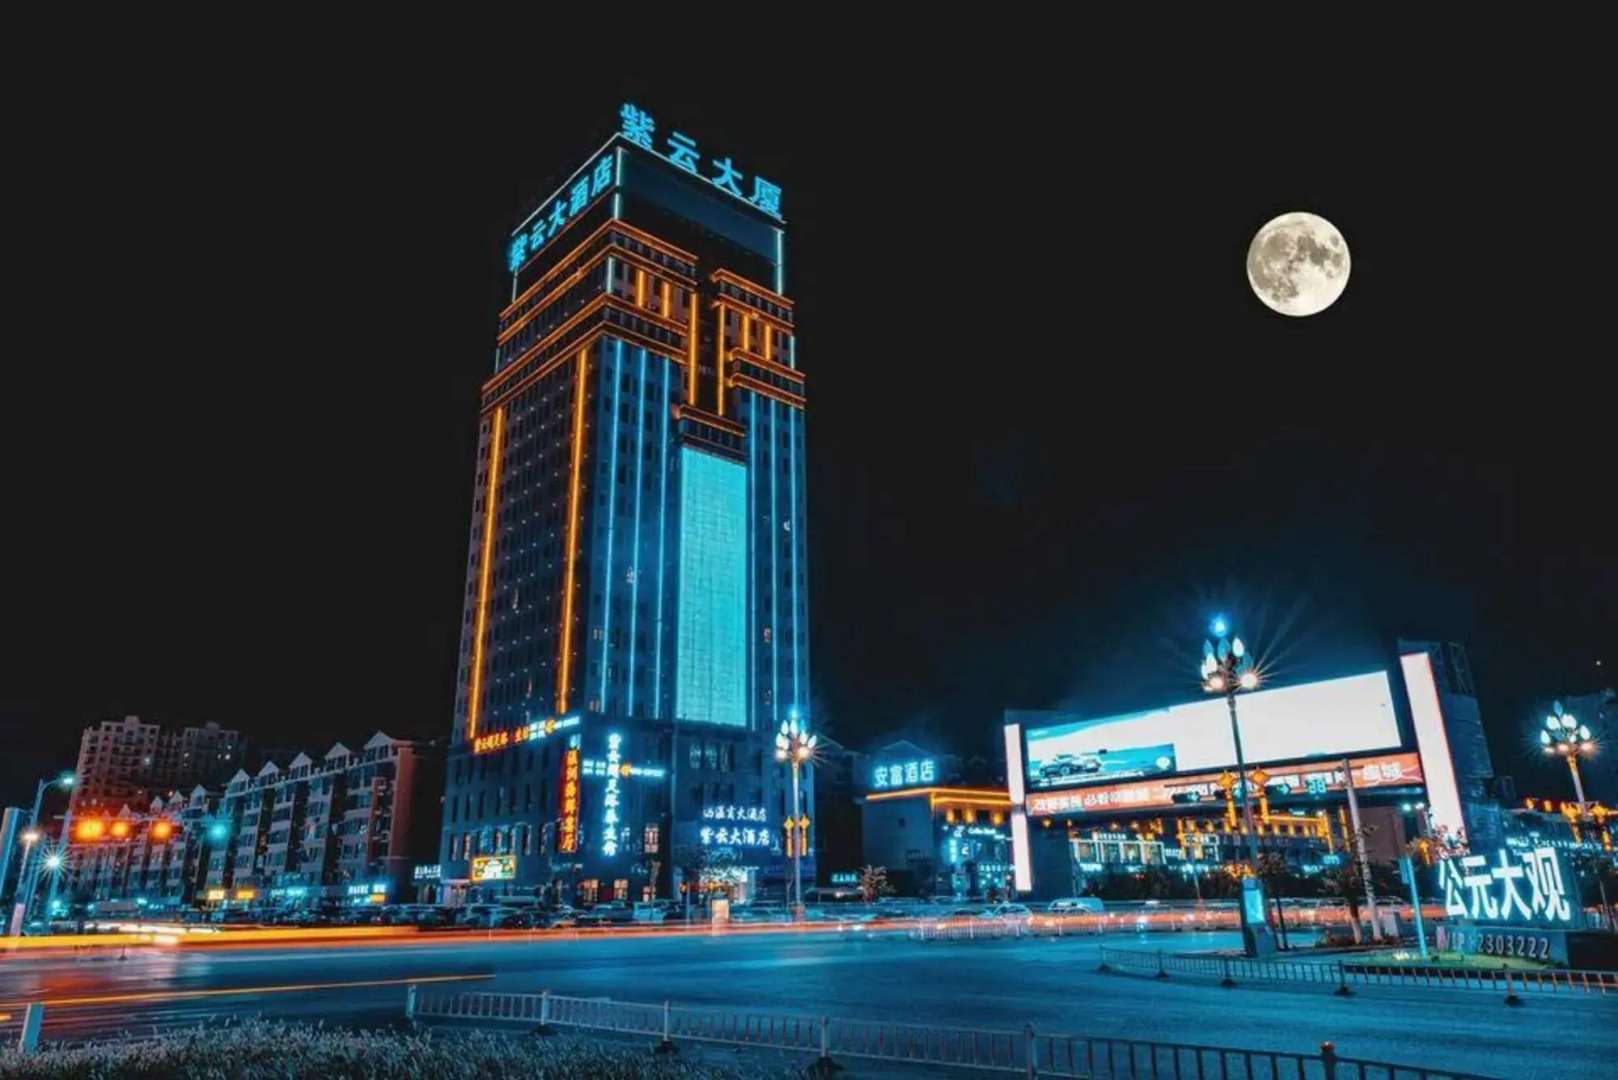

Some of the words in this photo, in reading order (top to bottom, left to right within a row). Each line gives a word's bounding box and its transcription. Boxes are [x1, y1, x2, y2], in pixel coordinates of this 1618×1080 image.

[620, 102, 783, 220] 紫云大厦
[509, 154, 614, 272] 紫云大酒店
[874, 760, 935, 788] 安富酒店
[700, 825, 770, 846] 紫云大酒店
[1438, 847, 1571, 922] 公元大观
